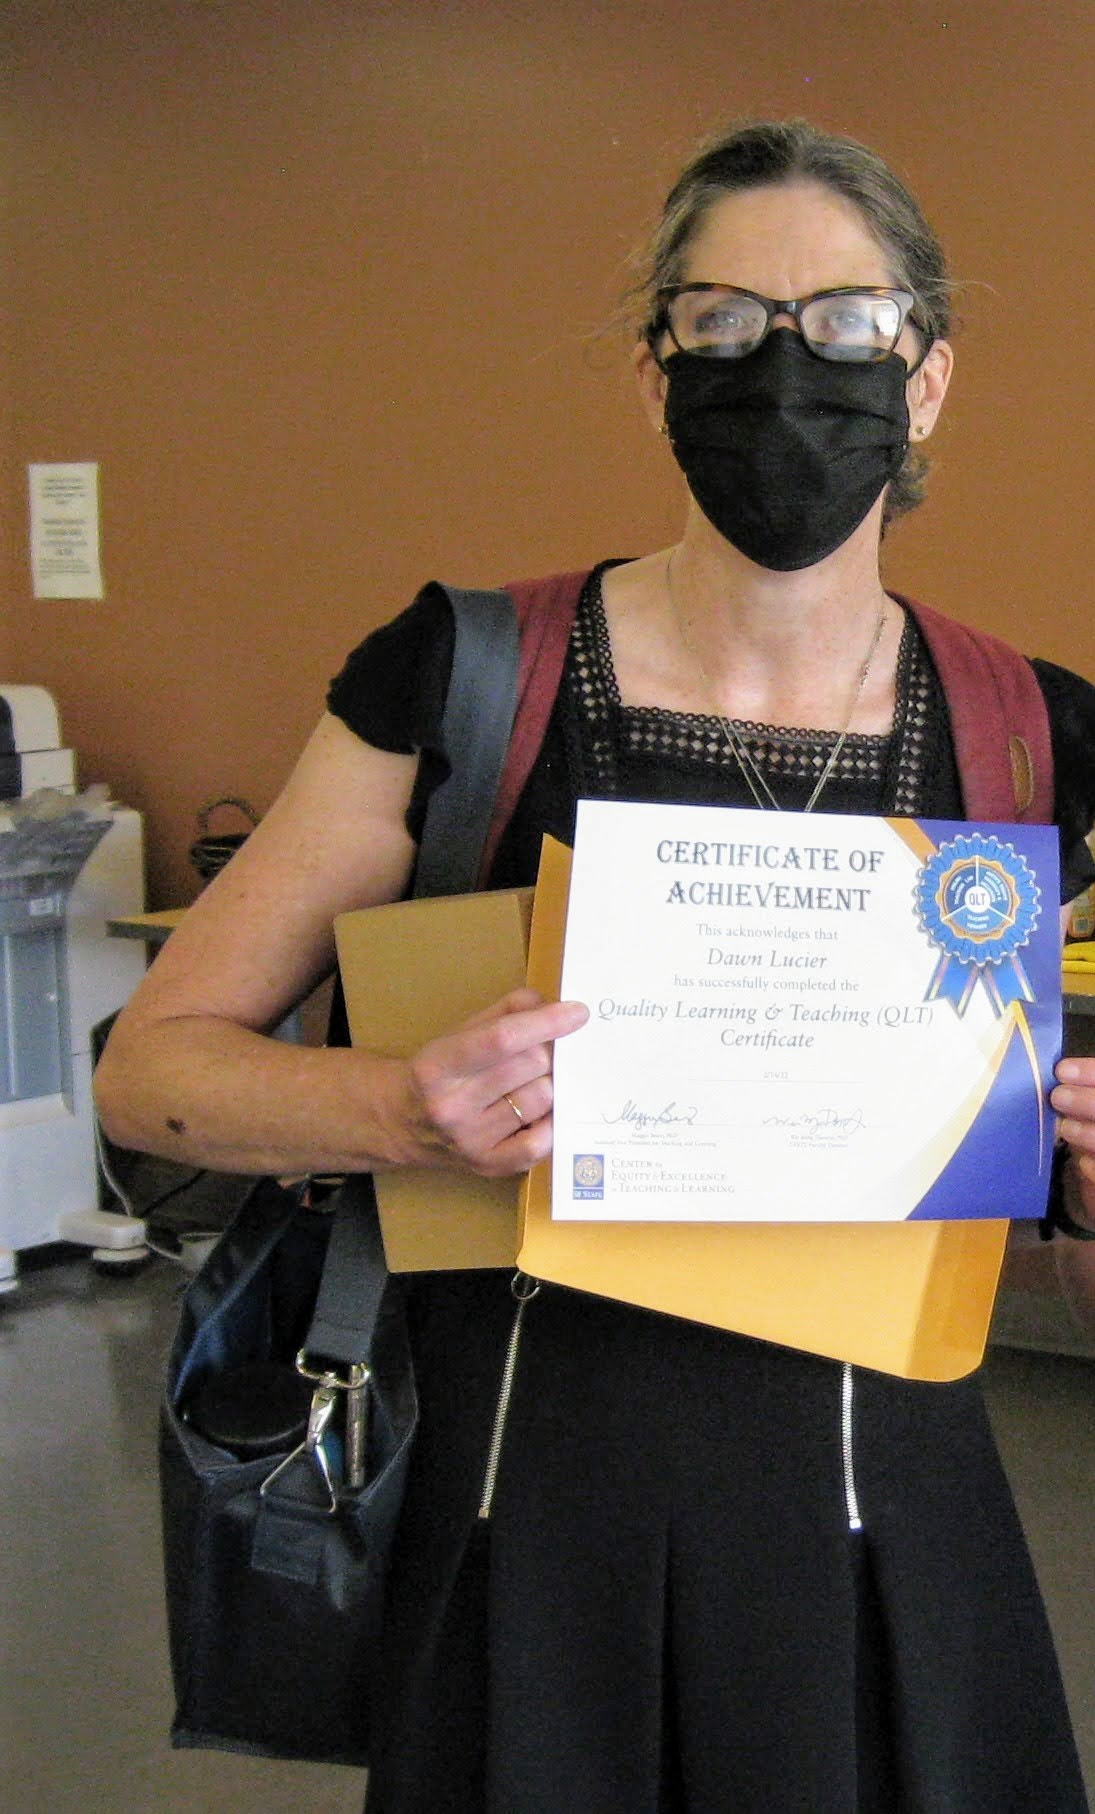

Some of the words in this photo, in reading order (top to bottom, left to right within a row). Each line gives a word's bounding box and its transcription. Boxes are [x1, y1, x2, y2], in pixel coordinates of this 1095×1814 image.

[656, 839, 841, 873] CERTIFICATE
[848, 849, 886, 873] OF
[666, 881, 872, 913] ACHIEVEMENT
[969, 892, 986, 905] QLT
[696, 923, 721, 938] This
[725, 925, 811, 942] acknowledges
[814, 928, 838, 941] that
[707, 947, 763, 968] Dawn
[769, 951, 828, 969] Lucier
[674, 973, 695, 988] has
[698, 974, 770, 993] successfully
[773, 978, 835, 994] completed
[839, 980, 859, 991] the
[597, 998, 668, 1023] Quality
[675, 1001, 757, 1026] Learning
[763, 1004, 784, 1022] &
[792, 1004, 870, 1026] Teaching
[876, 1006, 934, 1027] (QLT)
[720, 1028, 815, 1049] Certificate
